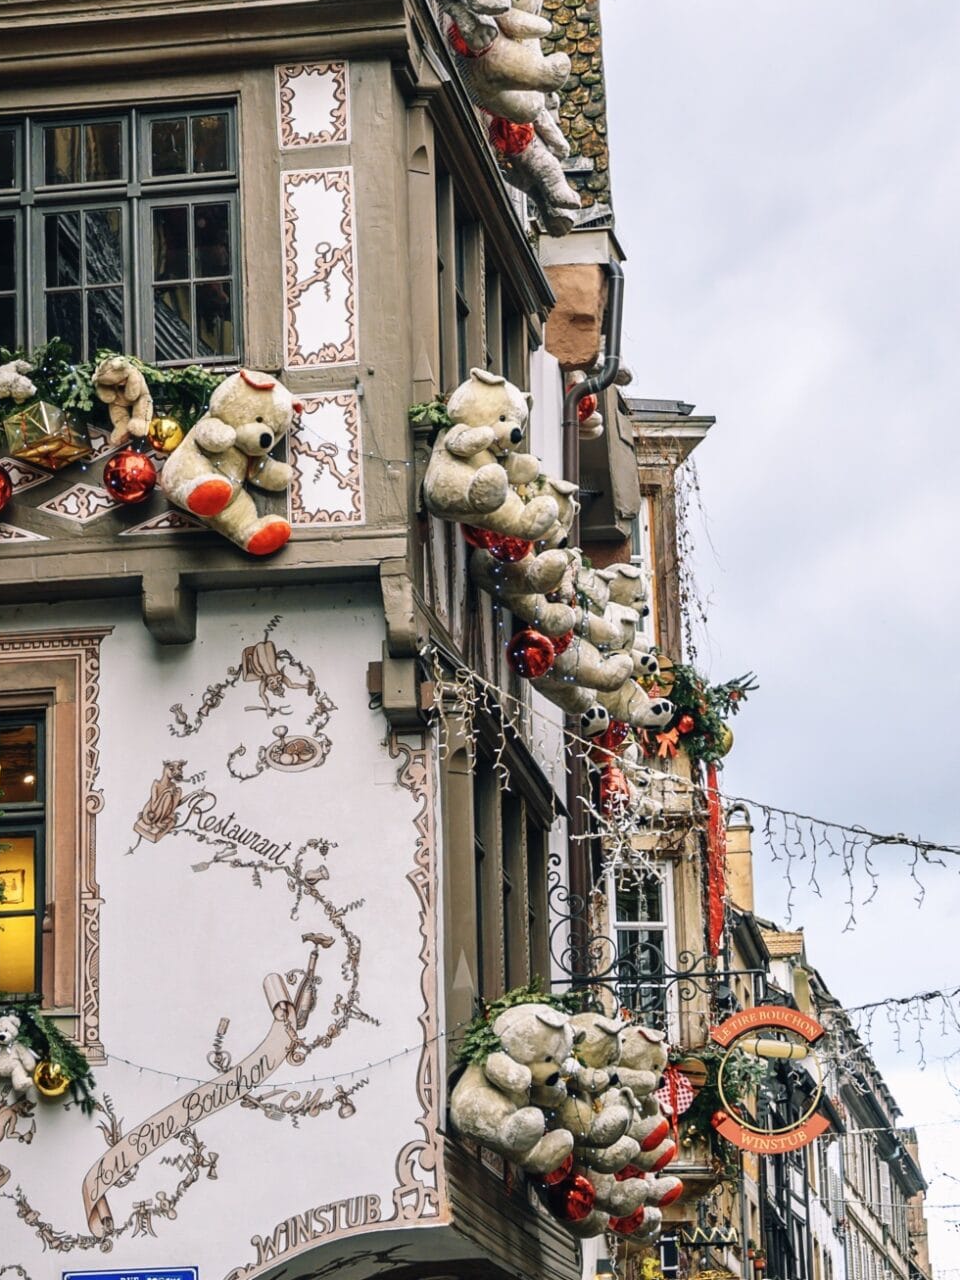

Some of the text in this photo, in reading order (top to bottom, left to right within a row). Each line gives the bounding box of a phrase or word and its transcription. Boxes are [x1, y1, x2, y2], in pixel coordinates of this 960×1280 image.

[173, 790, 292, 865] Restaurant
[716, 1010, 818, 1042] LE TIRE BOUCHON
[181, 1054, 277, 1128] Bouchon
[741, 1129, 807, 1151] WINSTUB
[250, 1192, 382, 1267] WINSTUB
